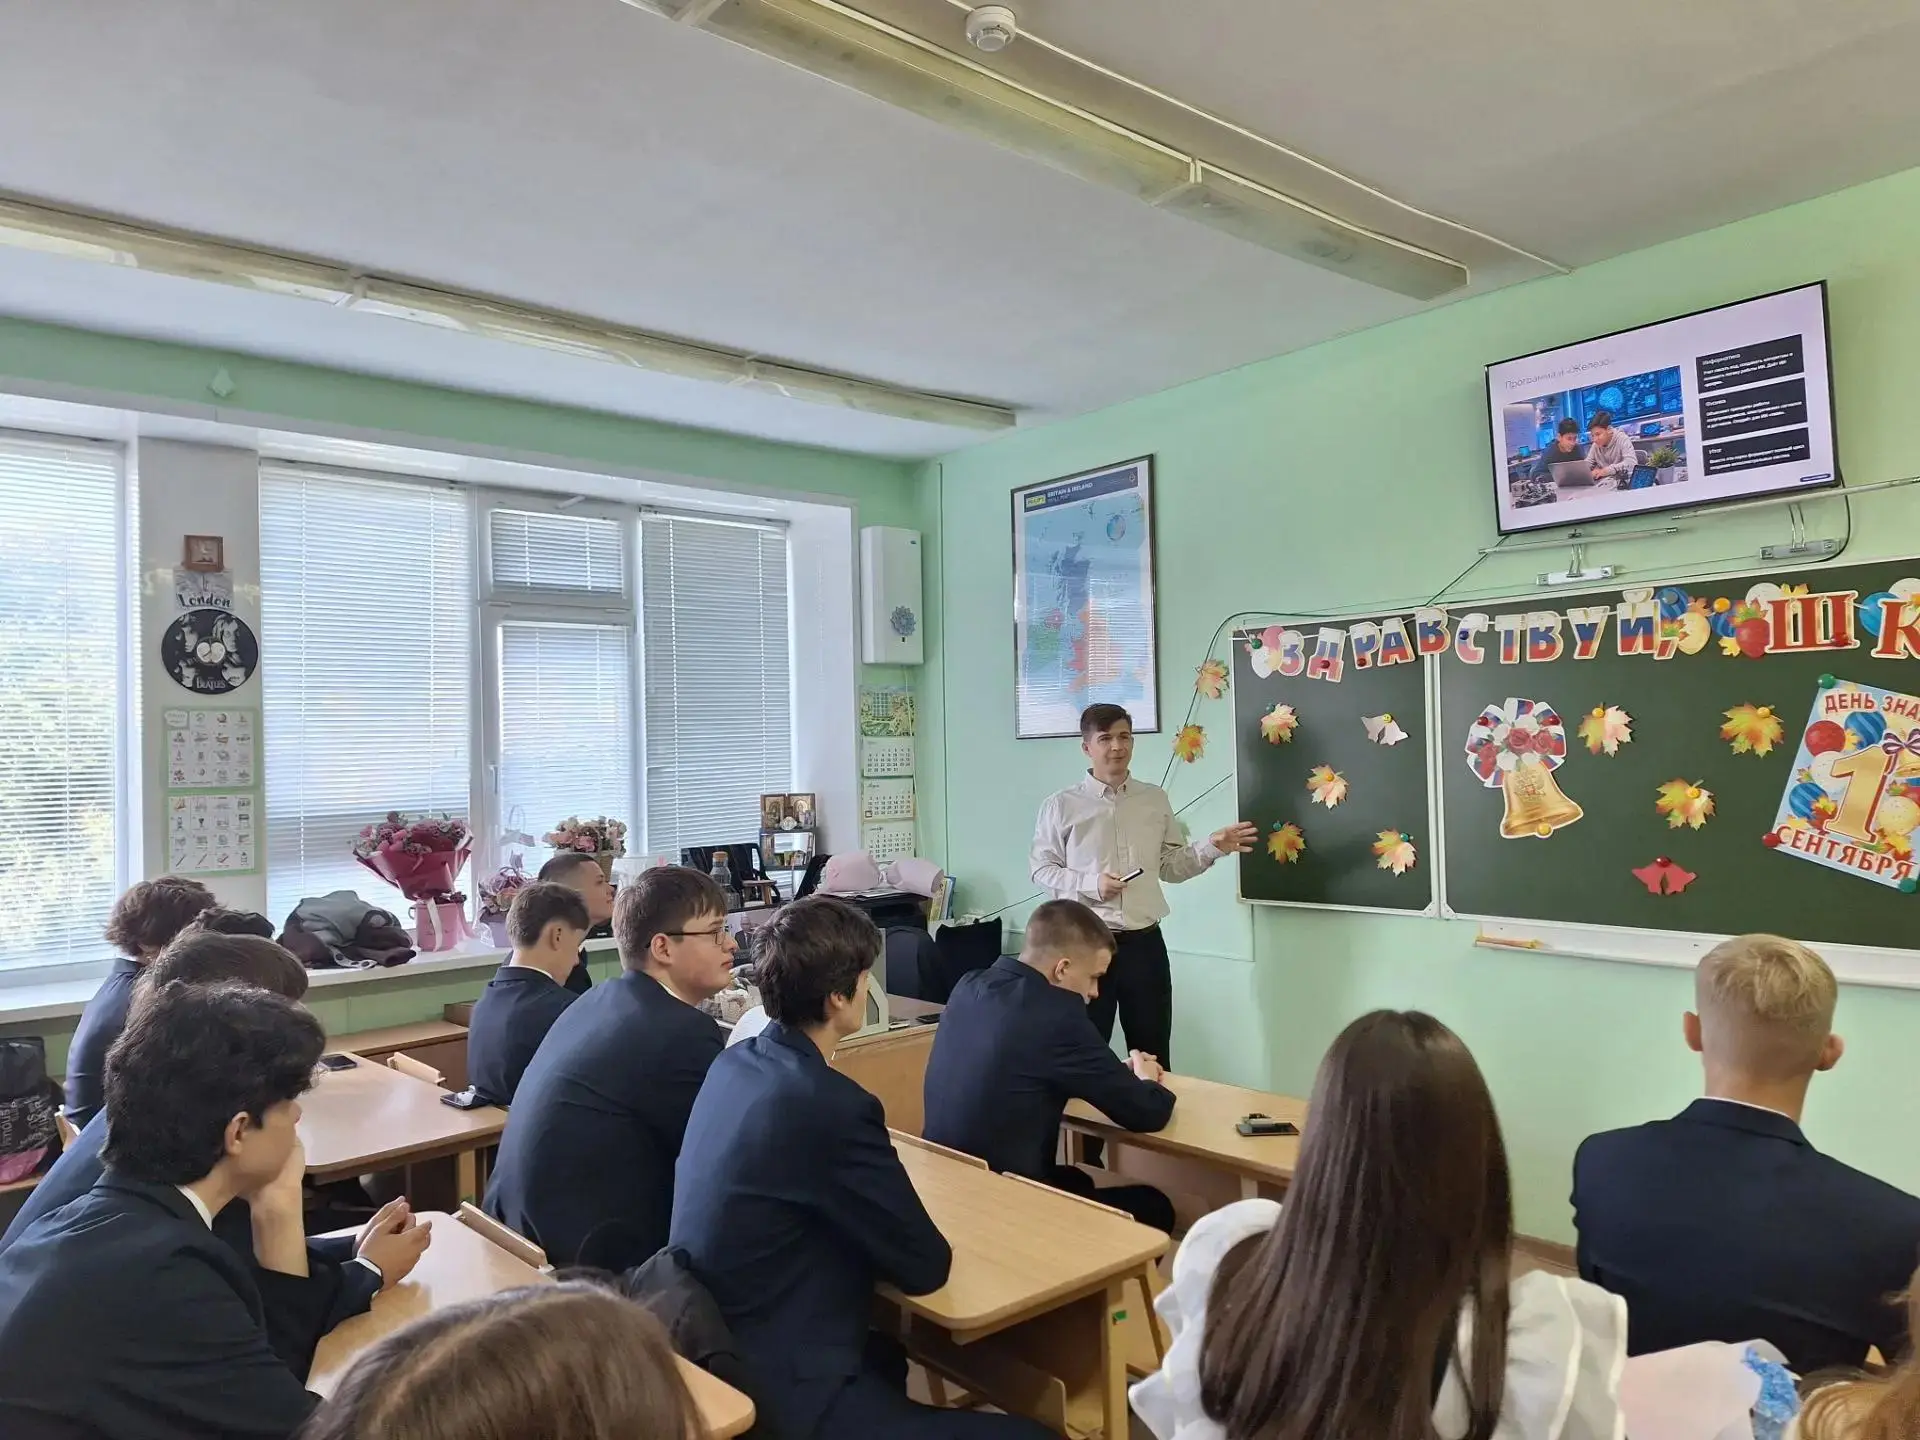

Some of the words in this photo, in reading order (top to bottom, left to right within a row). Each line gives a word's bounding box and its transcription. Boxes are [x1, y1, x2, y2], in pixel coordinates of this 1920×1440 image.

[176, 593, 231, 608] London
[1825, 692, 1875, 714] ДЕНЬ
[1882, 695, 1920, 722] ЗНА
[1824, 744, 1893, 844] 1
[1776, 825, 1914, 880] СЕНТЯБРЯ
